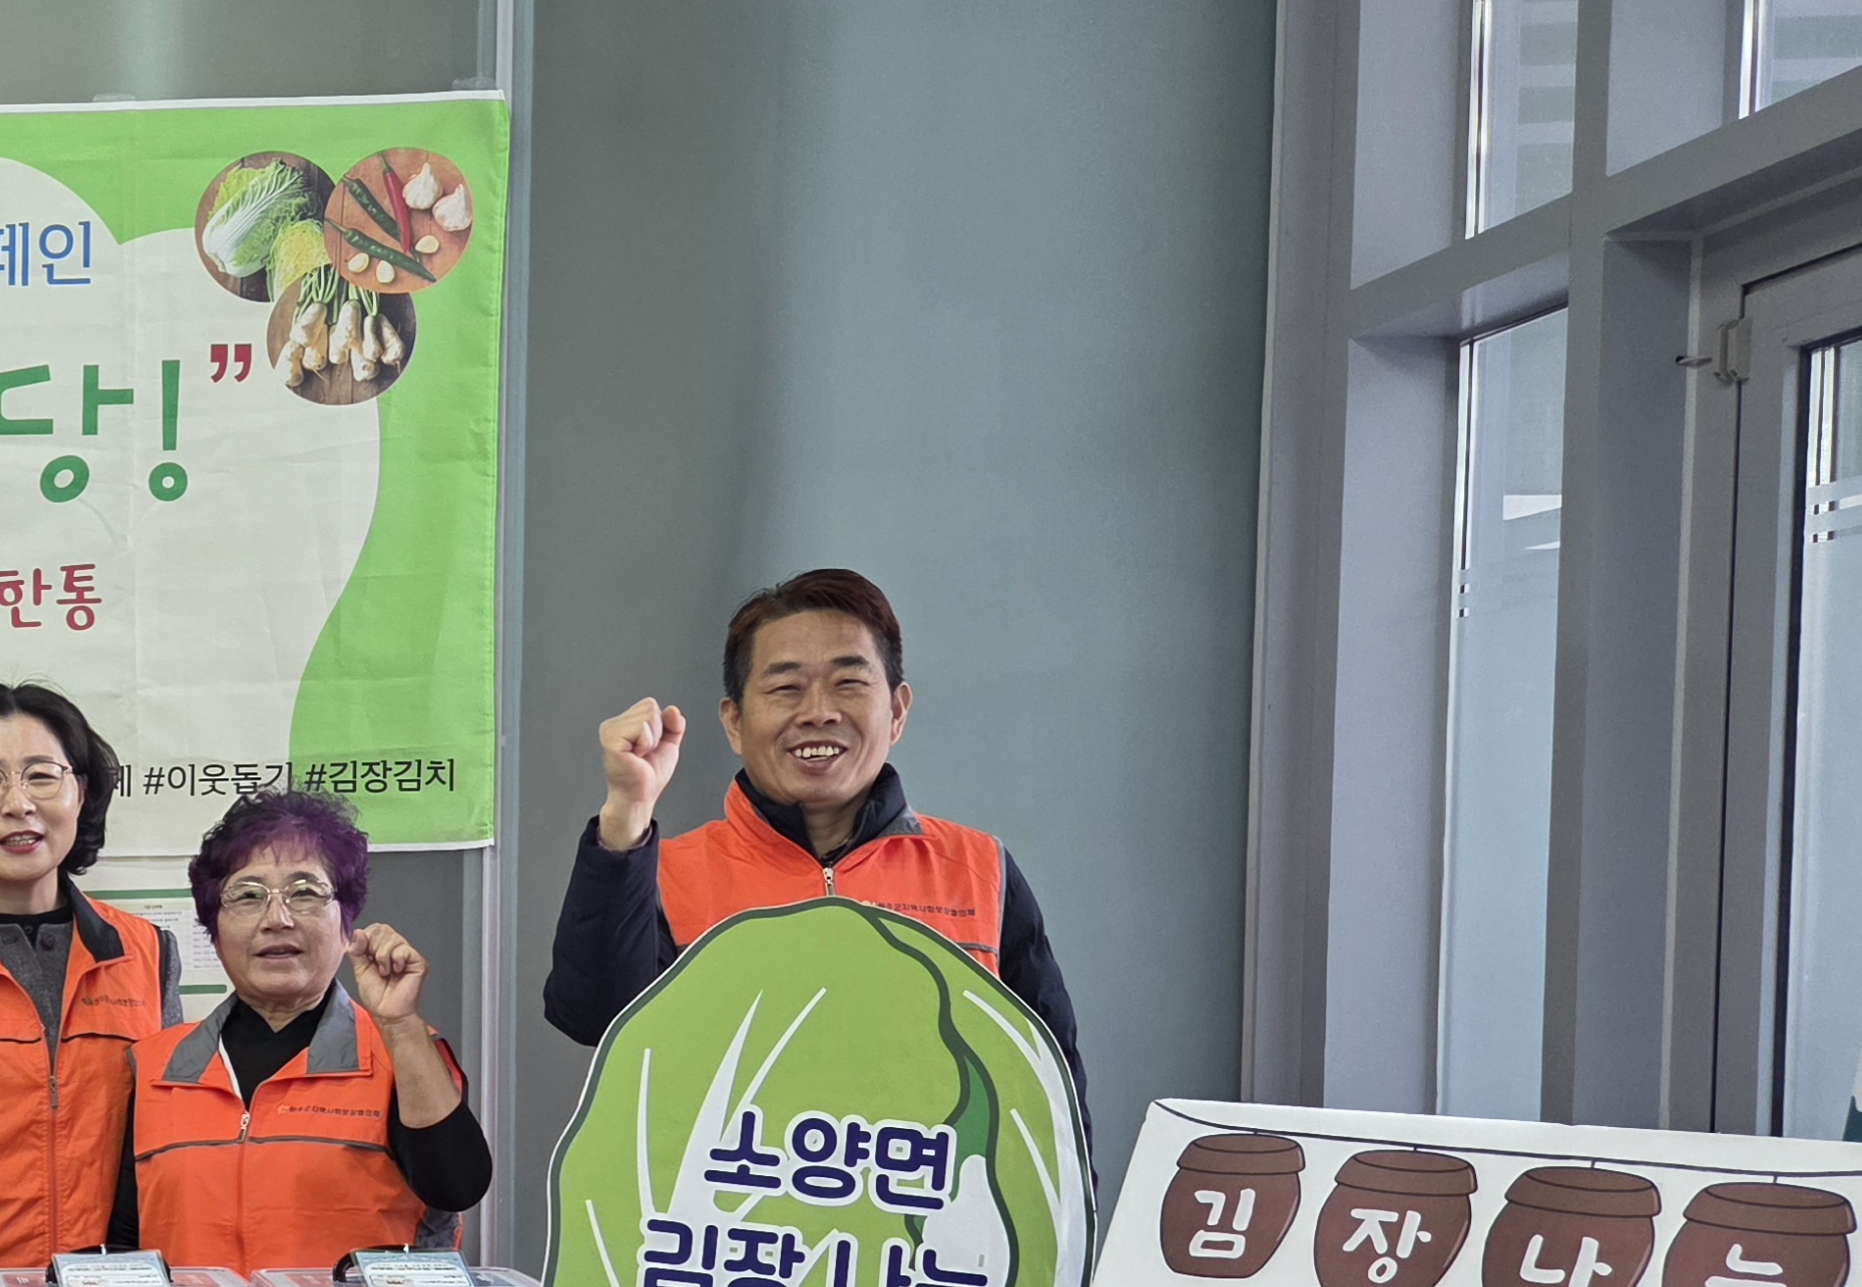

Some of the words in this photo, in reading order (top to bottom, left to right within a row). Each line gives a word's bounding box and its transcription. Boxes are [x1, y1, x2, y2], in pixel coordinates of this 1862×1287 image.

[142, 761, 294, 797] #이웃돕기
[303, 757, 457, 795] #김장김치
[704, 1110, 950, 1211] 소양면
